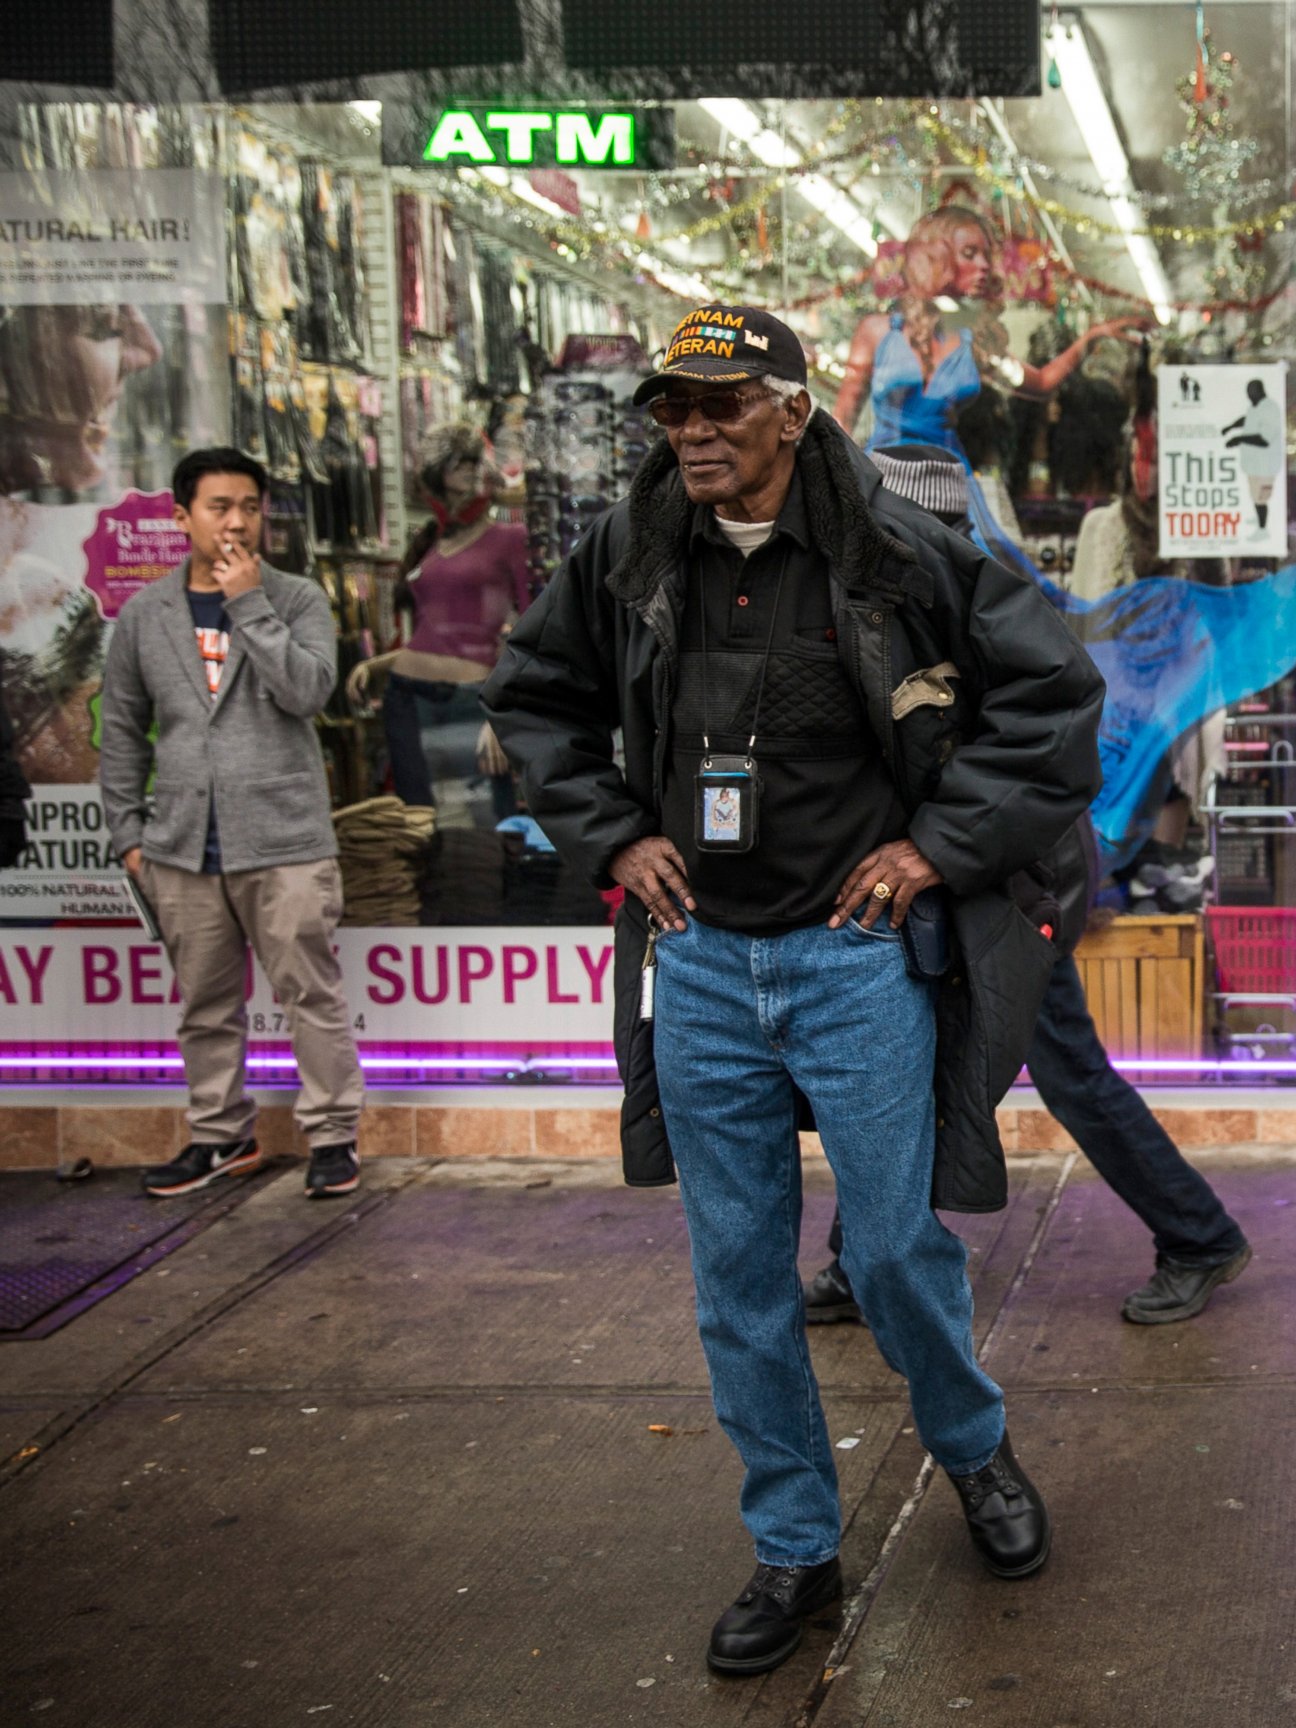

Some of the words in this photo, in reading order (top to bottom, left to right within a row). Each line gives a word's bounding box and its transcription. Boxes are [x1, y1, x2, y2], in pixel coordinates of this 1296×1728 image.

[423, 110, 634, 165] ATM
[110, 218, 190, 241] HAIR!
[1165, 452, 1236, 483] This
[1165, 484, 1240, 510] Stops
[1165, 512, 1241, 538] TODAY
[17, 840, 124, 870] ATURA
[43, 883, 120, 896] NATURAL
[61, 902, 124, 914] HUMAN
[366, 944, 614, 1005] SUPPLY
